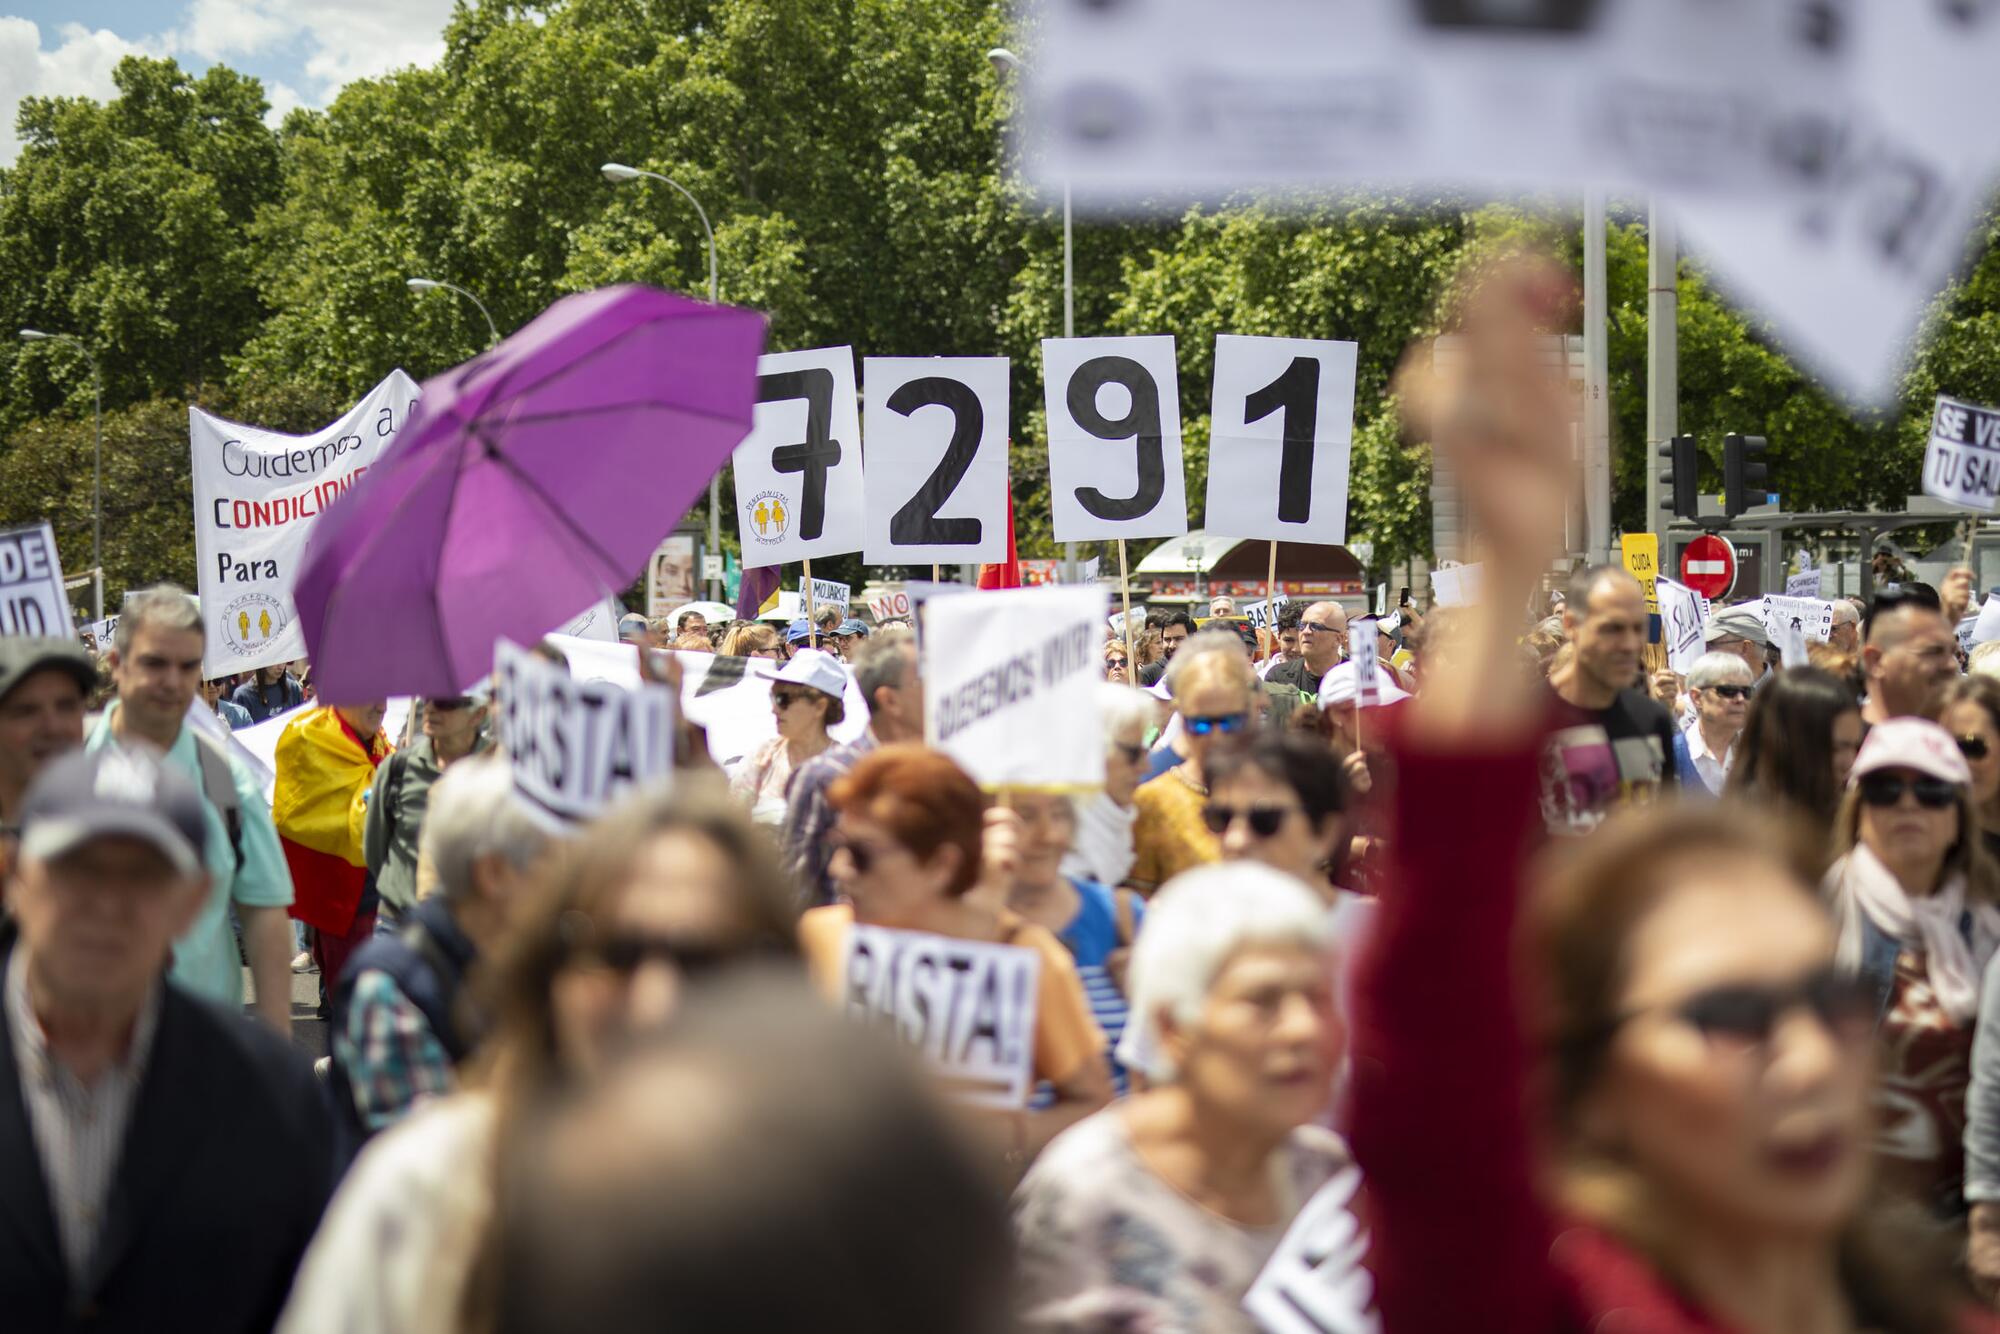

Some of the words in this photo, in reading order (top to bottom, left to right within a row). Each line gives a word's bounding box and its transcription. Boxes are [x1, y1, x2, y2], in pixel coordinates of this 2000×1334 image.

[1936, 405, 1969, 441] SE
[222, 433, 362, 478] Cuidemos
[755, 368, 841, 541] 7
[886, 376, 984, 545] 2
[1066, 356, 1165, 521] 9
[1244, 356, 1320, 524] 1
[1933, 447, 1960, 488] TU
[218, 552, 279, 583] Para
[1631, 553, 1652, 571] CUIDA
[813, 582, 847, 602] MOJARSE
[870, 593, 910, 618] NO
